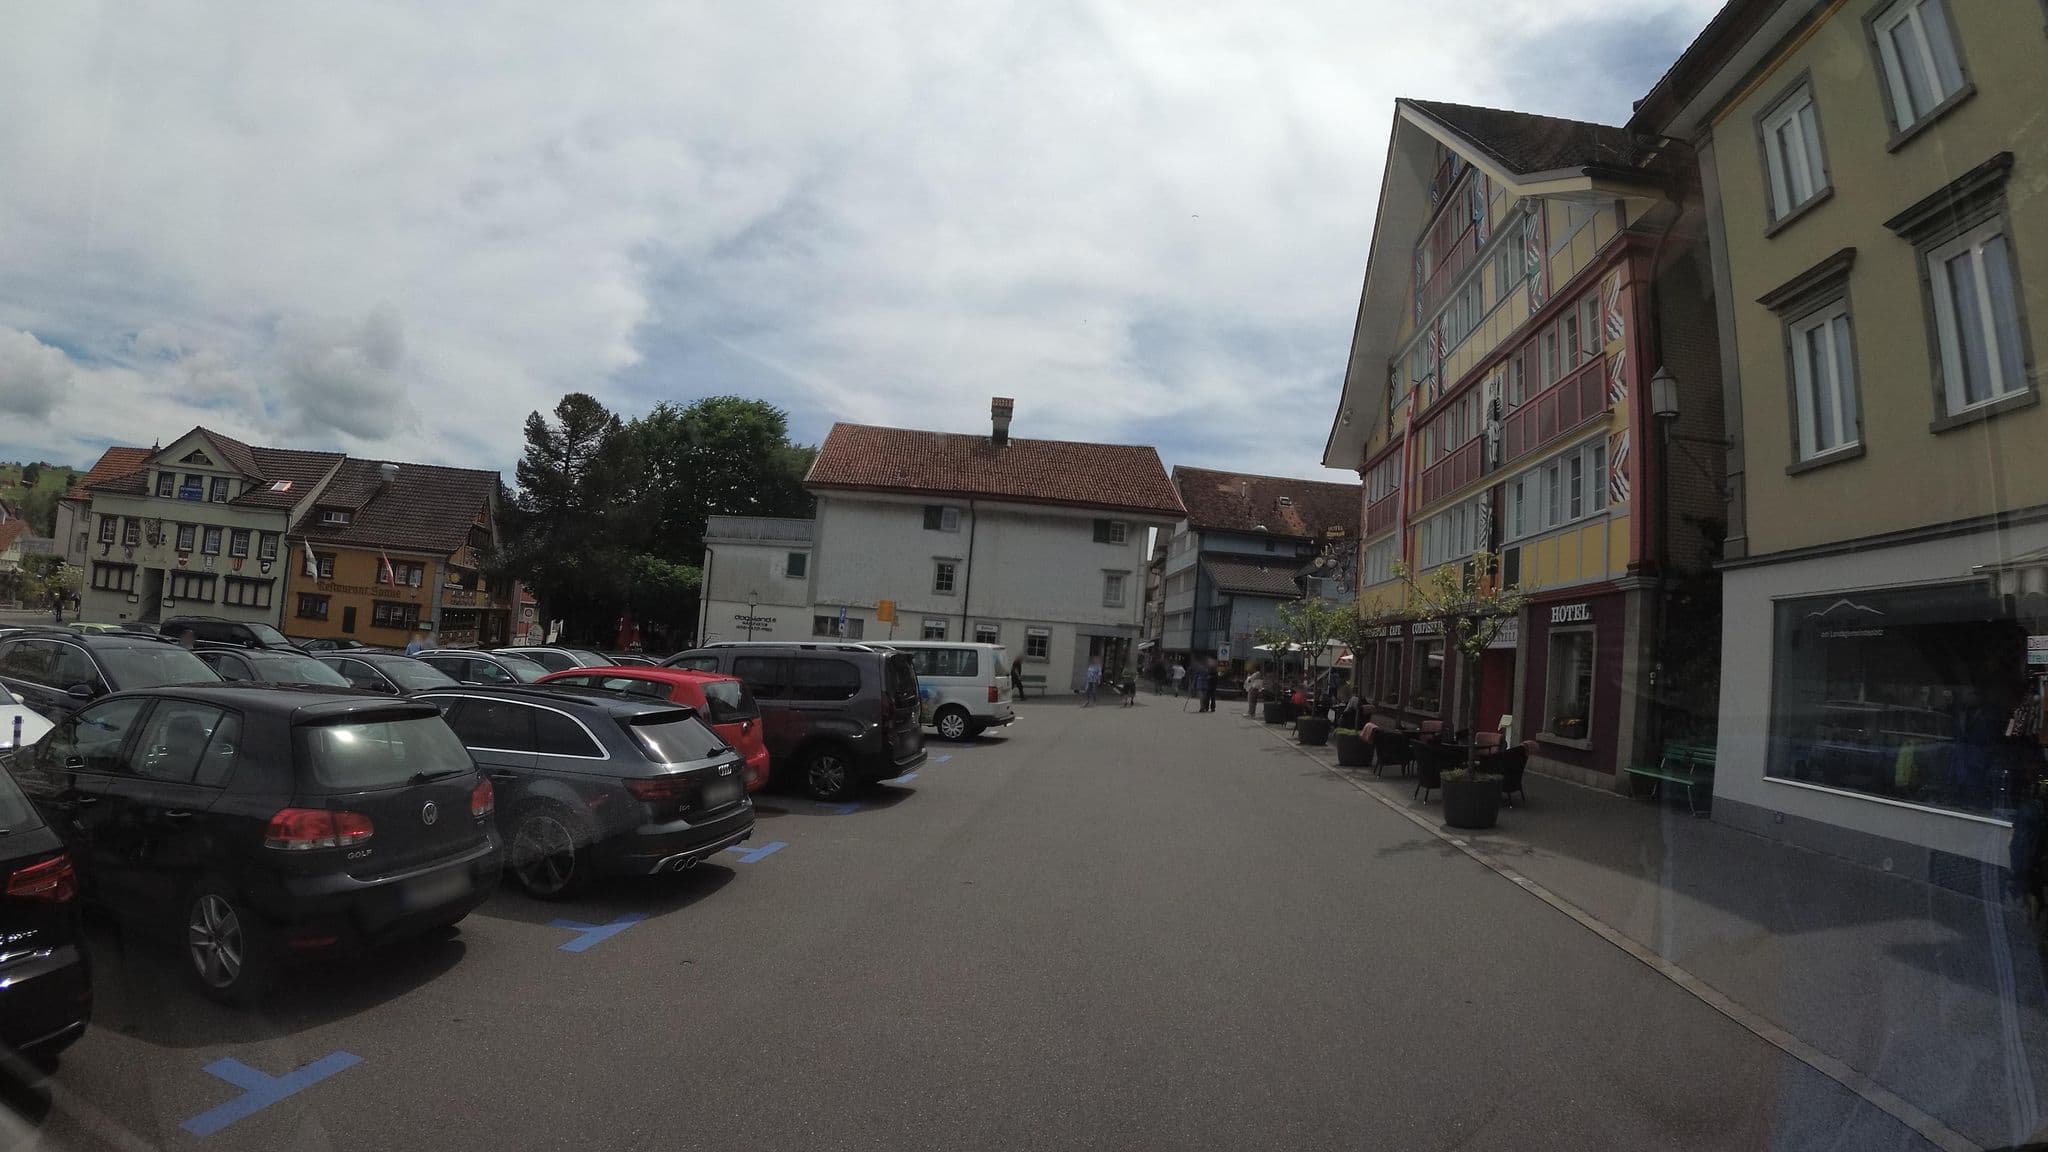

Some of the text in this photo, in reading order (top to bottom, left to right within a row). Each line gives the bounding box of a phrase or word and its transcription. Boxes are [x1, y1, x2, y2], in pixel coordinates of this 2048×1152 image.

[318, 581, 369, 595] Restaurant
[1550, 603, 1590, 623] HOTEL
[347, 848, 373, 860] GOLF
